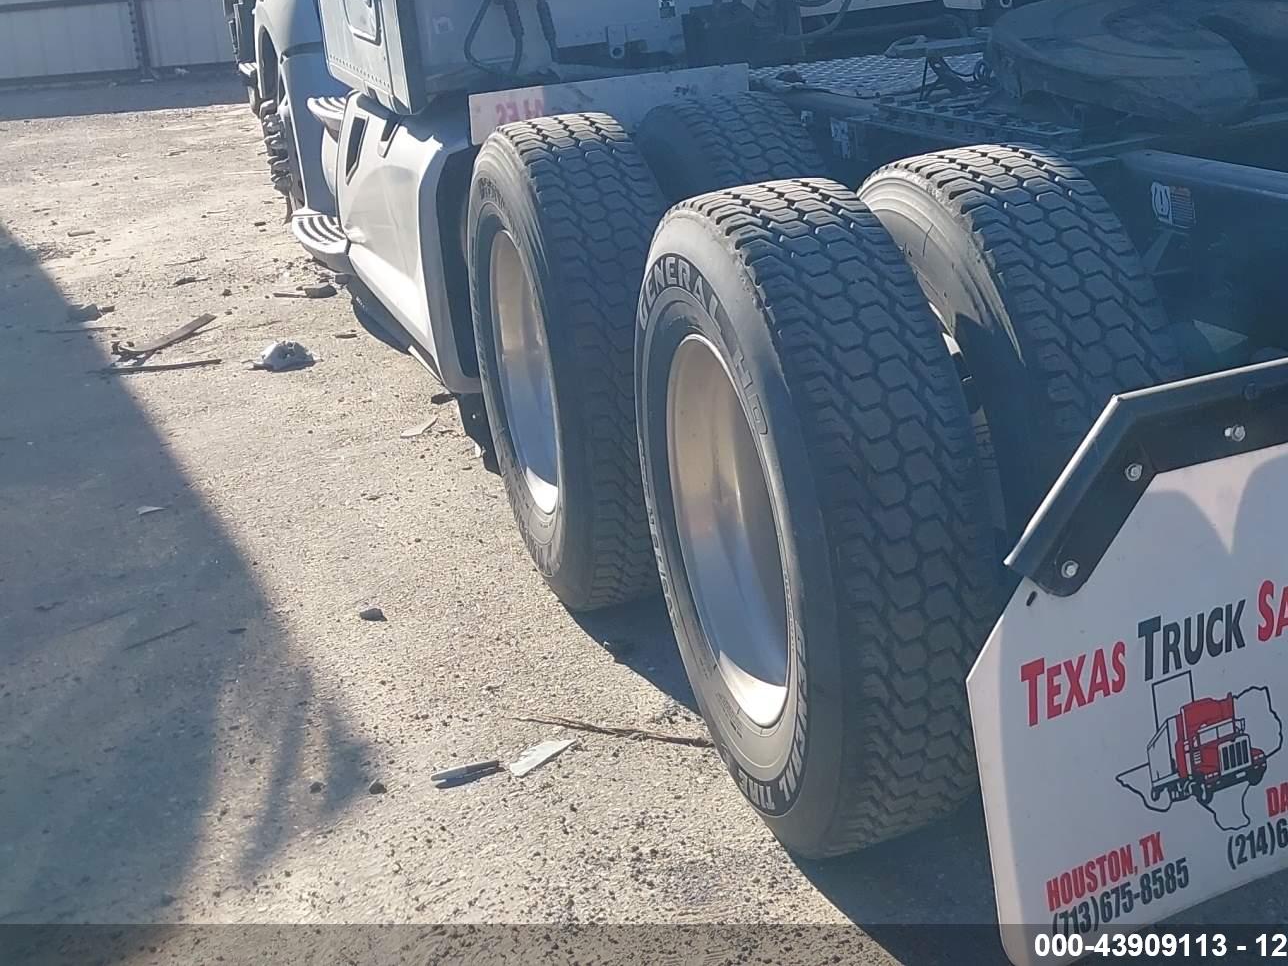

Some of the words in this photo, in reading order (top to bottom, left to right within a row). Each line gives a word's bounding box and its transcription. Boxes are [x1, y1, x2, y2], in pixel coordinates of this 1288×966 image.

[639, 255, 723, 335] GENERAL
[1020, 641, 1127, 728] TEXAS
[1137, 598, 1247, 682] TRUCK
[1045, 844, 1139, 912] HOUSTON,
[1139, 831, 1165, 868] TX
[1051, 857, 1190, 938] (713)675-8585
